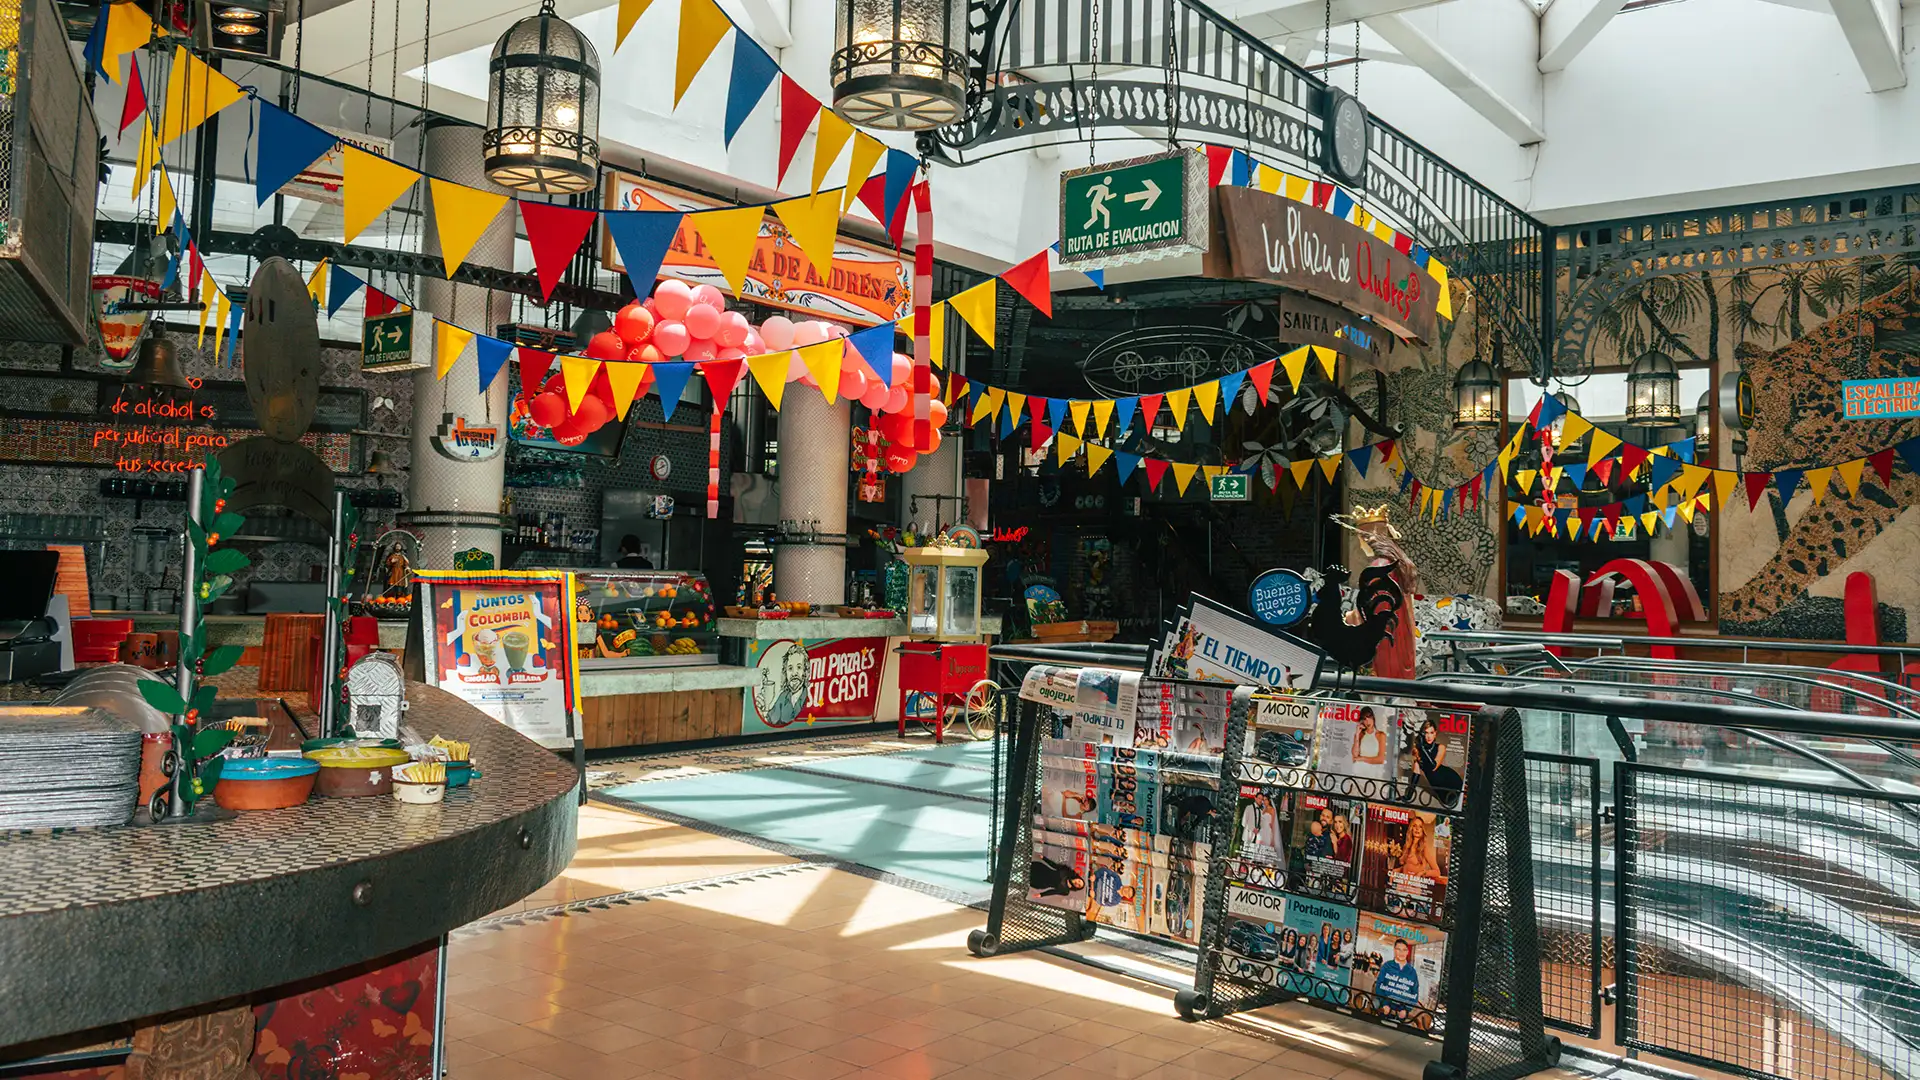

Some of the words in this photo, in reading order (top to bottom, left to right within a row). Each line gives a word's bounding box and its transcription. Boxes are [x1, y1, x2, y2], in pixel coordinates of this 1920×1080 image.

[1067, 234, 1093, 254] RUTA
[1096, 231, 1110, 249] DE
[1112, 219, 1180, 246] EVACUACION
[1262, 223, 1289, 274] La
[1287, 206, 1336, 281] Plaza
[1338, 243, 1351, 284] de
[772, 252, 800, 282] DE
[1284, 311, 1328, 334] SANTA
[111, 396, 129, 414] de
[134, 397, 194, 421] alcohol
[200, 404, 215, 419] es
[93, 425, 180, 449] perjudicial
[184, 434, 229, 454] para
[114, 455, 142, 473] tus
[471, 593, 525, 612] JUNTOS
[1256, 583, 1301, 602] Buenas
[1256, 594, 1302, 613] nuevas
[469, 610, 531, 628] COLOMBIA
[1203, 636, 1220, 661] EL
[1224, 644, 1282, 687] TIEMPO
[806, 681, 825, 708] SU
[828, 671, 869, 704] CASA
[1039, 686, 1076, 704] ortafolio
[1083, 711, 1113, 729] TIEMPO
[1263, 701, 1310, 719] MOTOR
[1334, 703, 1361, 723] aló
[1115, 716, 1125, 730] EL
[1438, 713, 1468, 734] aló
[1234, 890, 1282, 912] MOTOR
[1293, 900, 1341, 921] Portafolio
[1373, 918, 1429, 945] Portafolio
